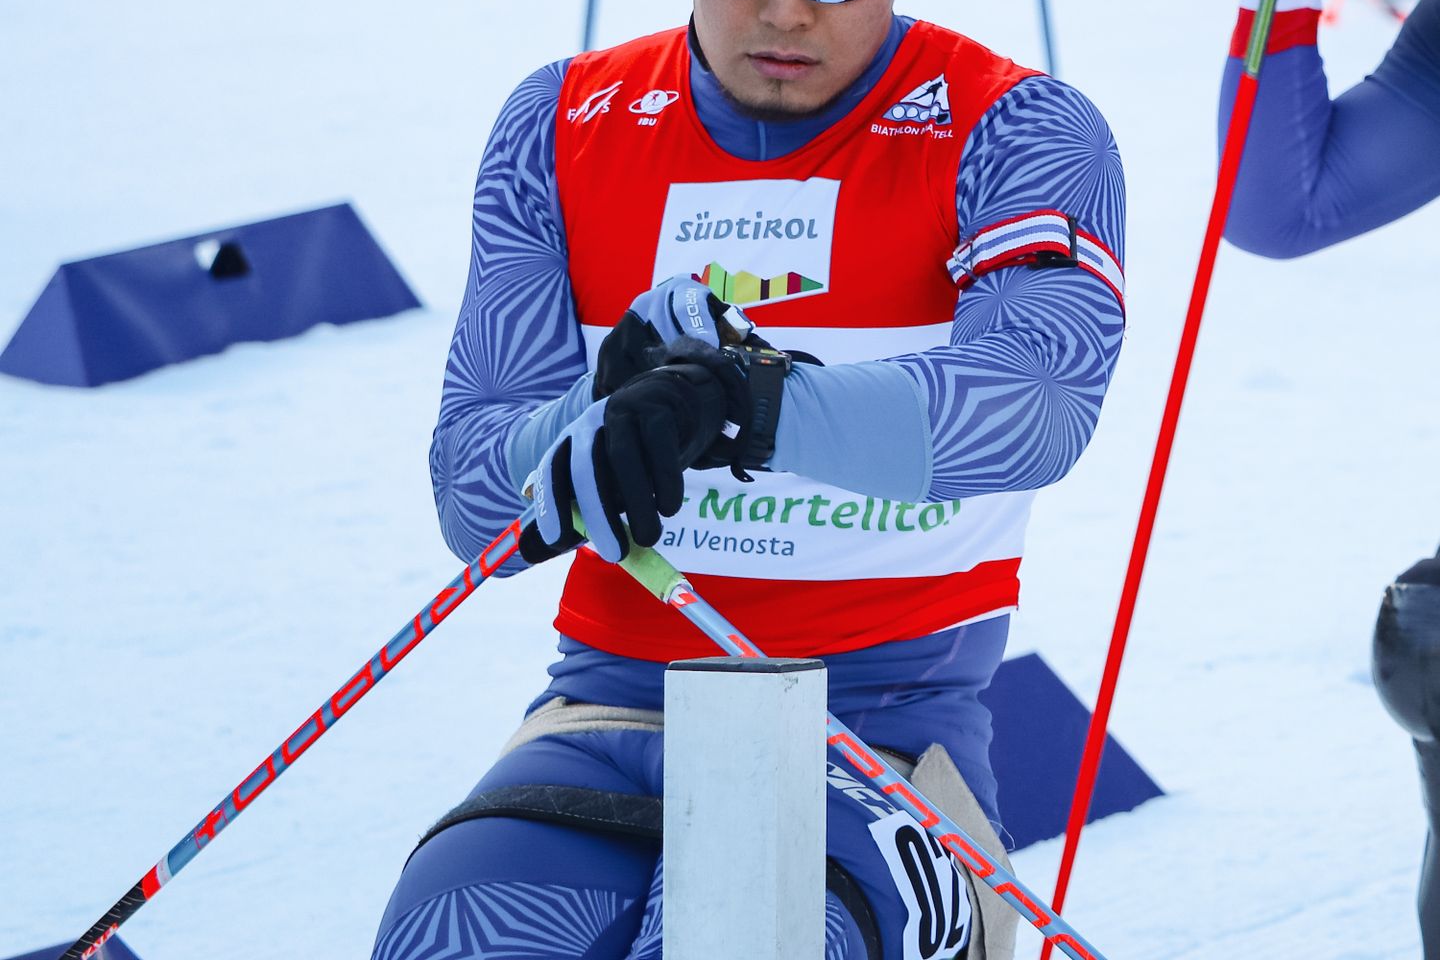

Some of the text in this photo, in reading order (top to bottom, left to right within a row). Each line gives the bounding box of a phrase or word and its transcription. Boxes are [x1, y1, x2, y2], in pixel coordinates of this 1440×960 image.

[637, 117, 657, 126] IBU
[871, 123, 919, 136] BIATHLON
[693, 530, 795, 557] Venosta
